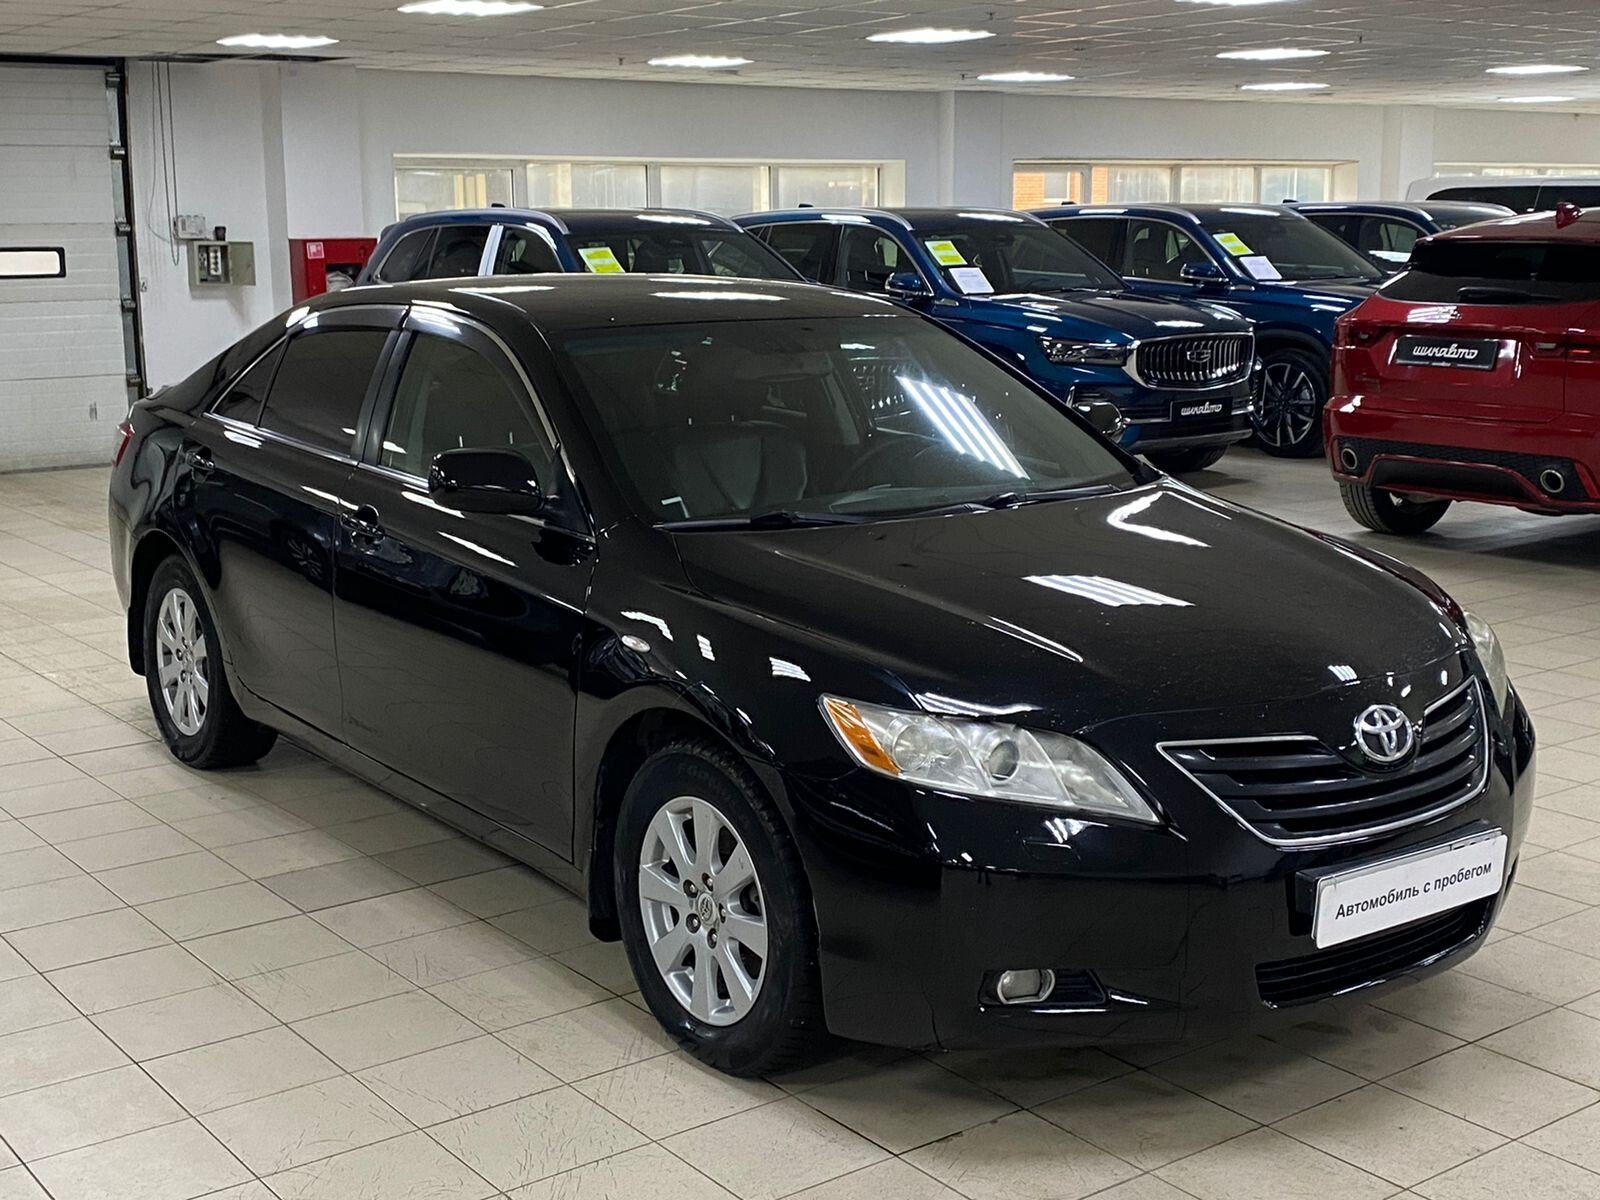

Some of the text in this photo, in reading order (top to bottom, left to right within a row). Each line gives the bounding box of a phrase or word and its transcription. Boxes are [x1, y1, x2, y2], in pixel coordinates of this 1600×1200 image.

[1335, 862, 1492, 920] Автомобиль с пробегом
